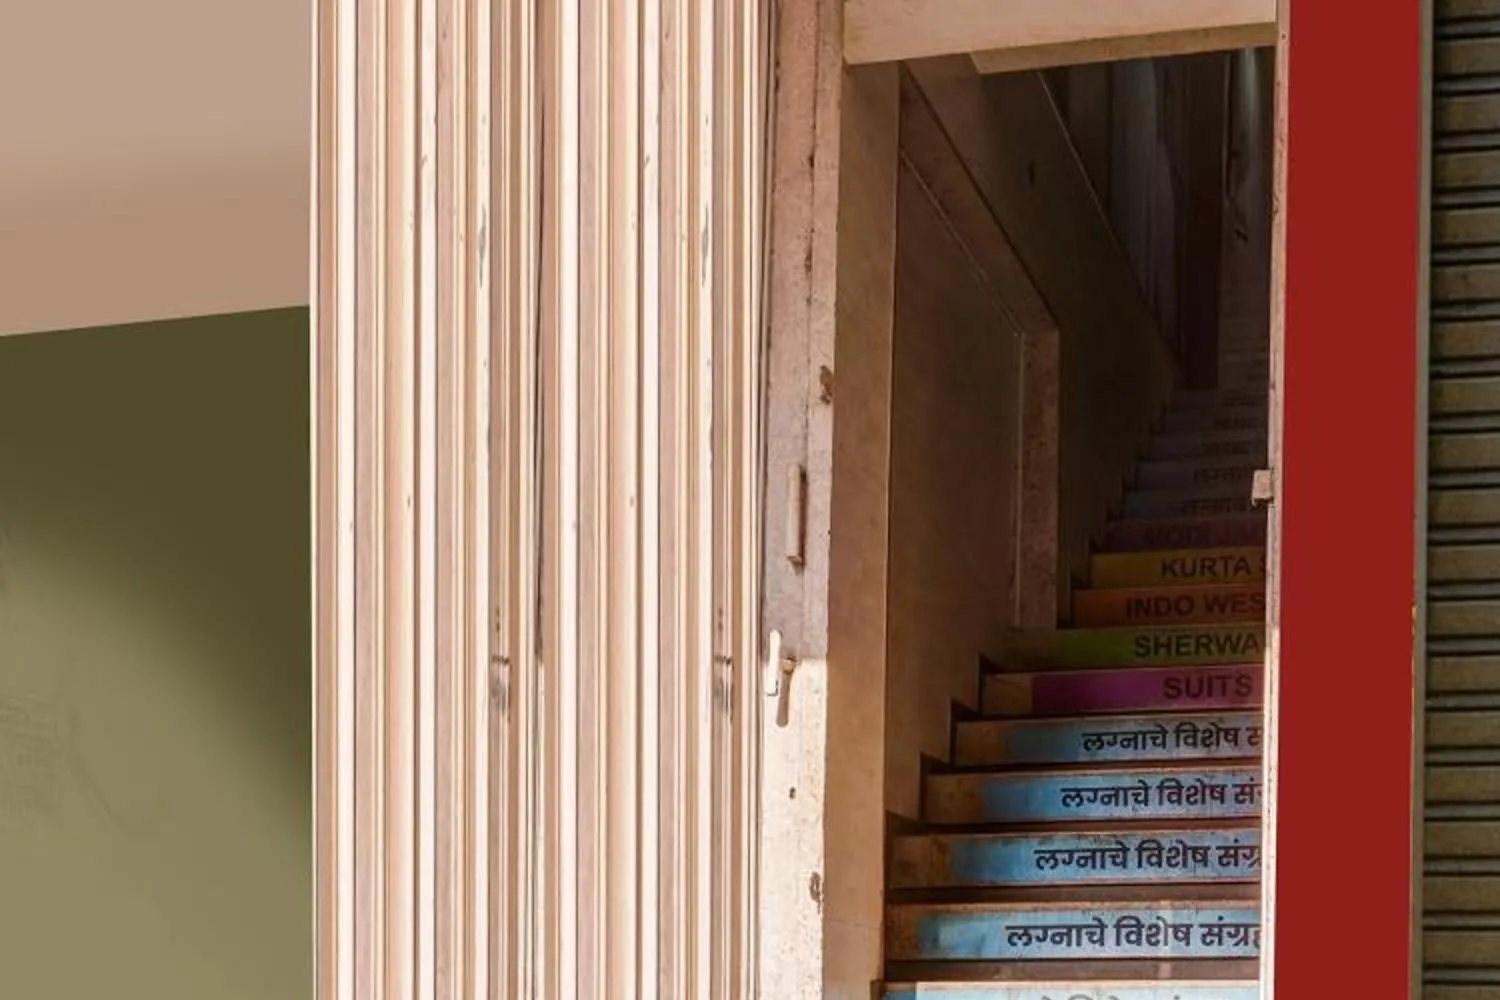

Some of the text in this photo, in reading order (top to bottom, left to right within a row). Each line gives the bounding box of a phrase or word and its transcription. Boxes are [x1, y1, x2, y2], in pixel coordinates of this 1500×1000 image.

[1162, 556, 1251, 578] KURTA
[1127, 595, 1195, 617] INDO
[1135, 632, 1260, 658] SHERWA
[1164, 674, 1254, 699] SUITS
[1081, 723, 1168, 751] लग्नाचे
[1173, 722, 1241, 748] विशेष
[1061, 777, 1263, 808] लग्नाचे विशेष सं
[1035, 840, 1130, 870] लग्नाचे
[1136, 839, 1211, 868] विशेष
[1005, 917, 1108, 948] लग्नाचे
[1113, 915, 1194, 946] विशेष
